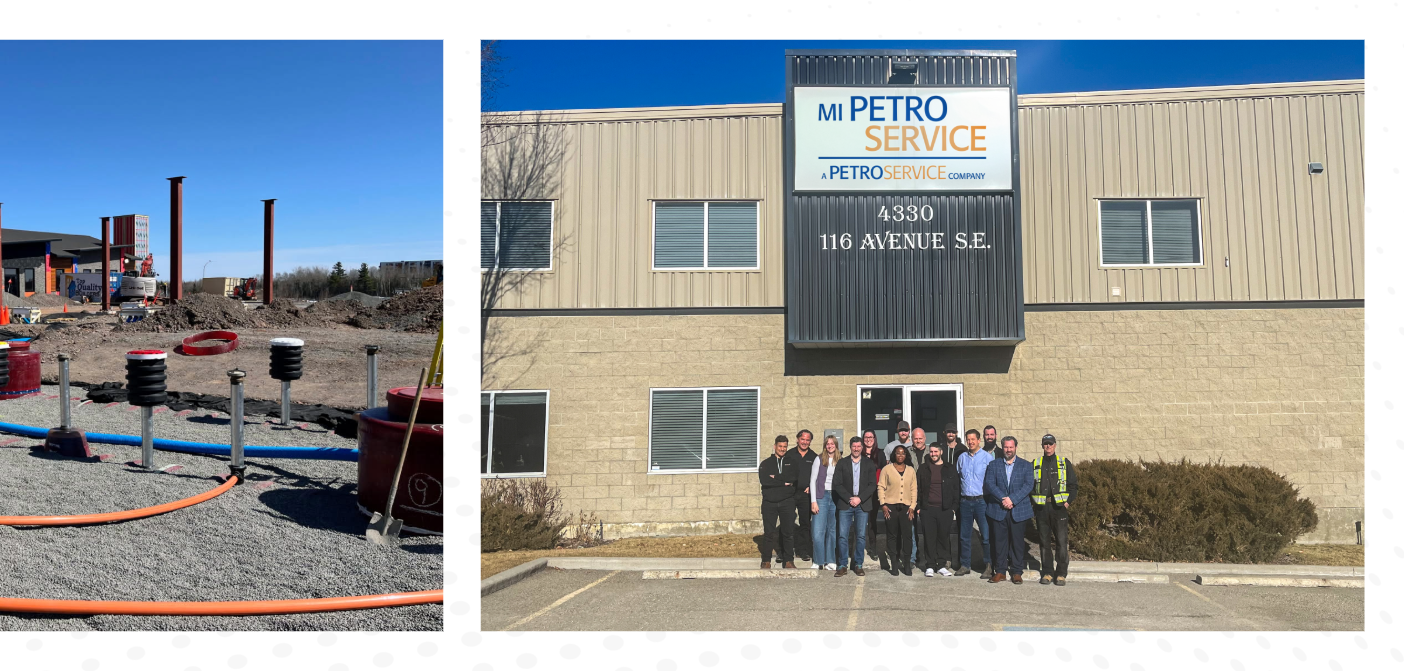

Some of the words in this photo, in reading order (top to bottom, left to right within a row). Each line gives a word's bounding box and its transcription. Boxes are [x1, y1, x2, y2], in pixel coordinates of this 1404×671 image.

[818, 103, 843, 121] MI
[850, 95, 948, 122] PETRO
[865, 125, 987, 152] SERVICE
[830, 165, 946, 180] PETROSERVICE
[878, 205, 934, 222] 4330
[820, 233, 852, 250] 116
[860, 231, 945, 250] AVENUE
[954, 232, 991, 249] S.E.
[77, 283, 102, 292] Quality
